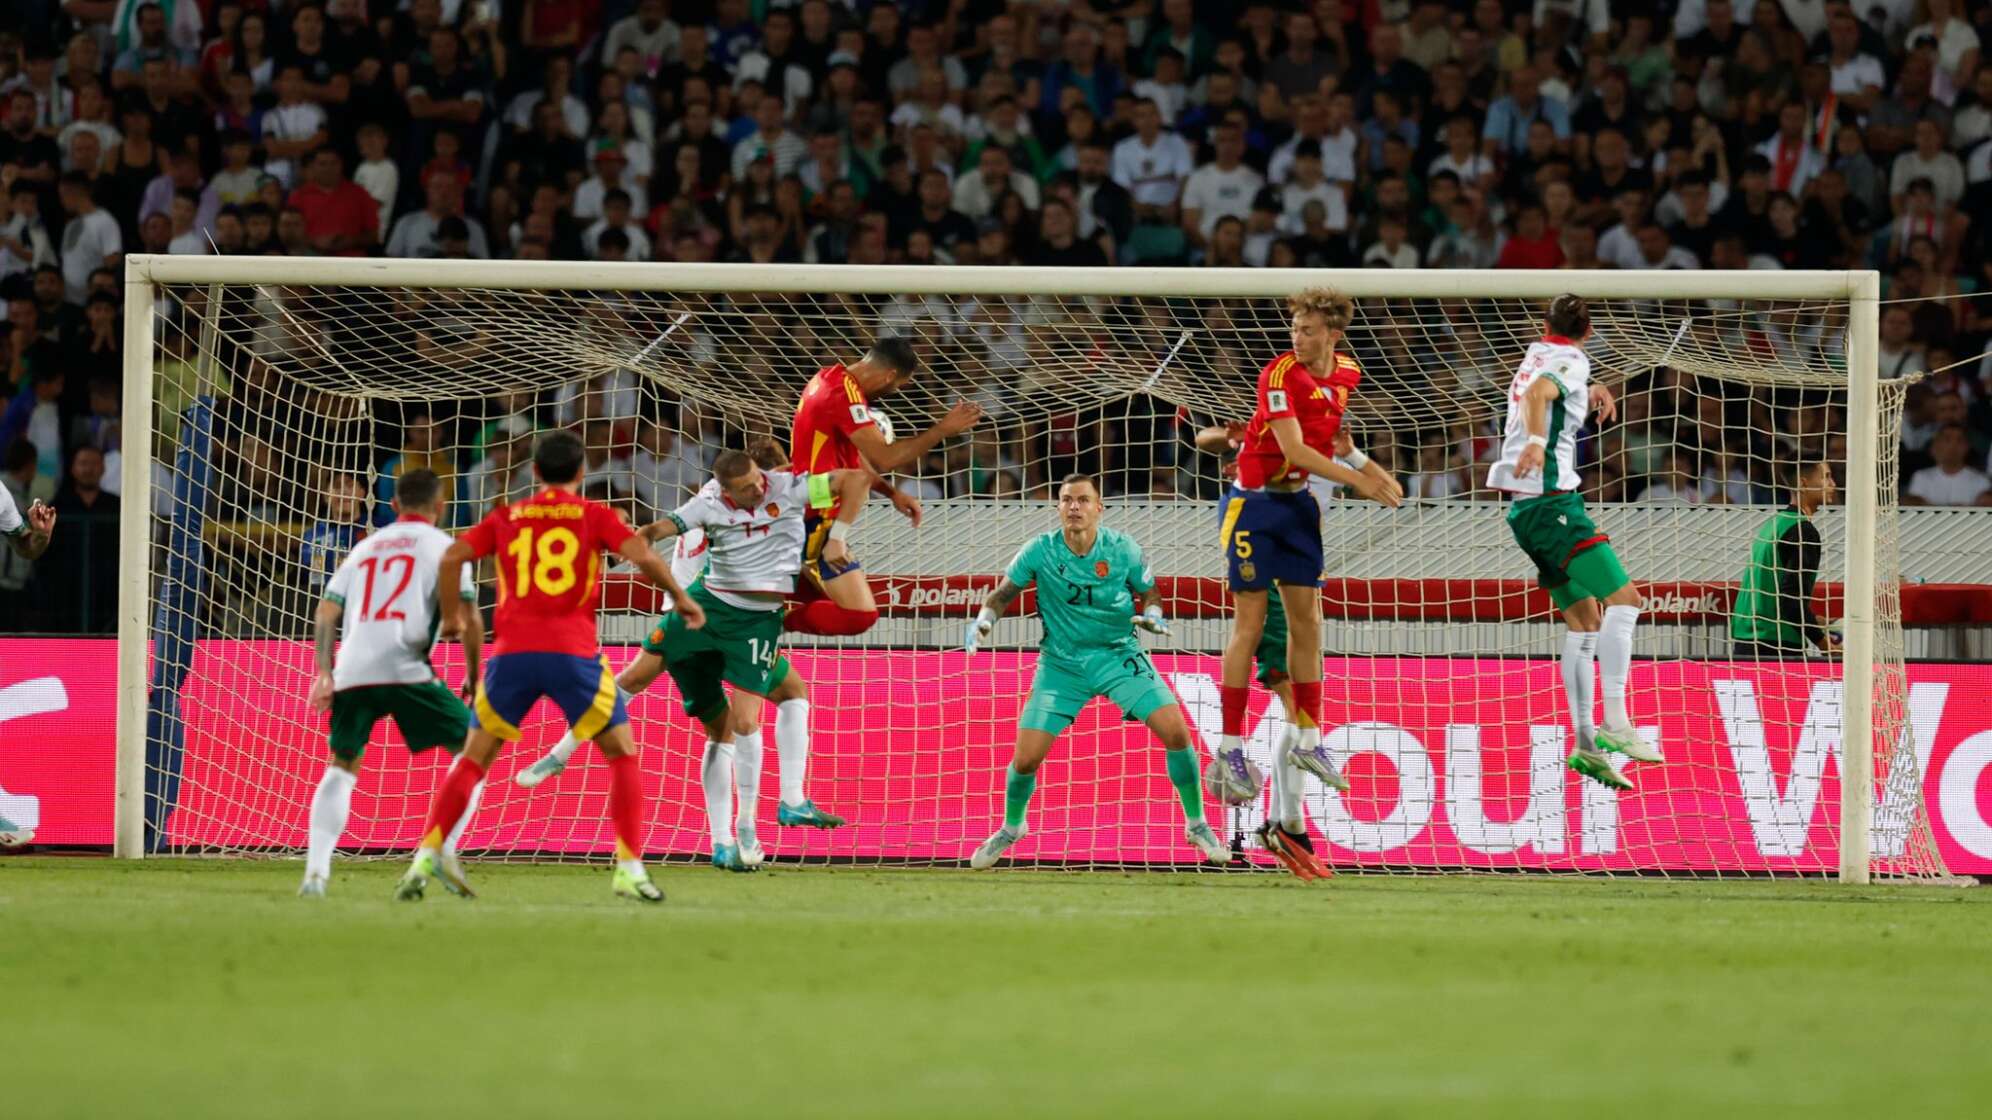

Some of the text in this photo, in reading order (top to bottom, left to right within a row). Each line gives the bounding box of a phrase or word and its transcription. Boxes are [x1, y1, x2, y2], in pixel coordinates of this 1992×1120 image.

[1234, 530, 1253, 559] 5
[508, 526, 579, 599] 18
[358, 553, 416, 622] 12
[1066, 582, 1093, 606] 21
[748, 638, 773, 669] 14
[1122, 652, 1153, 677] 21
